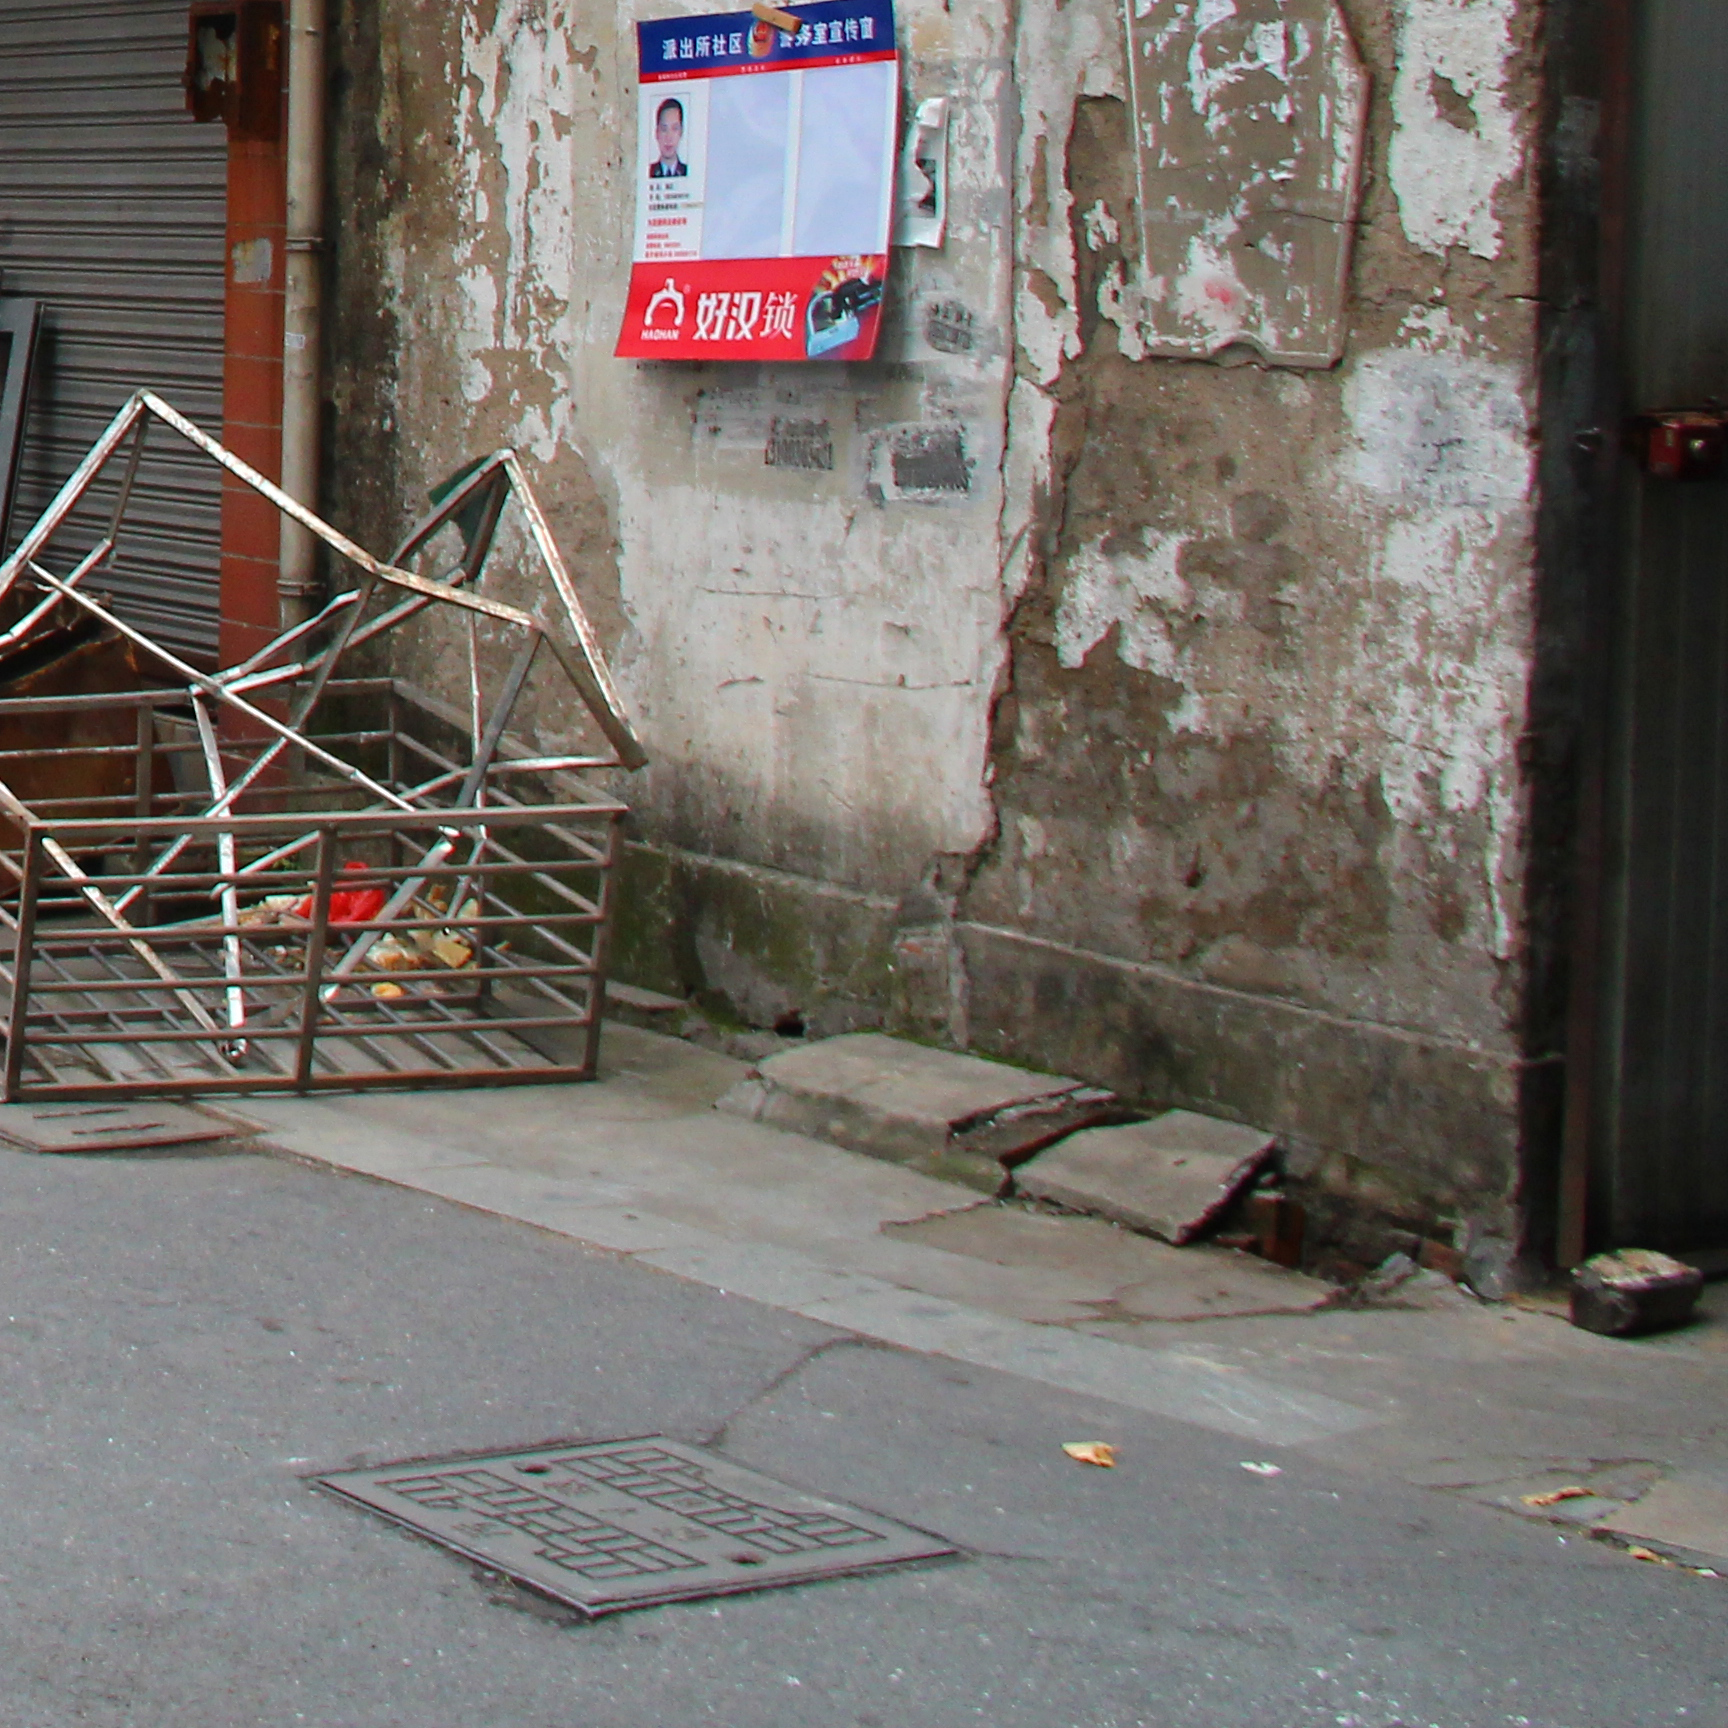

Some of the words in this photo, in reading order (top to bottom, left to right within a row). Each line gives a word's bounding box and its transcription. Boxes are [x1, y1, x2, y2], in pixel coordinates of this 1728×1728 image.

[662, 33, 743, 60] 派出所社区
[692, 292, 796, 341] 好汉锁
